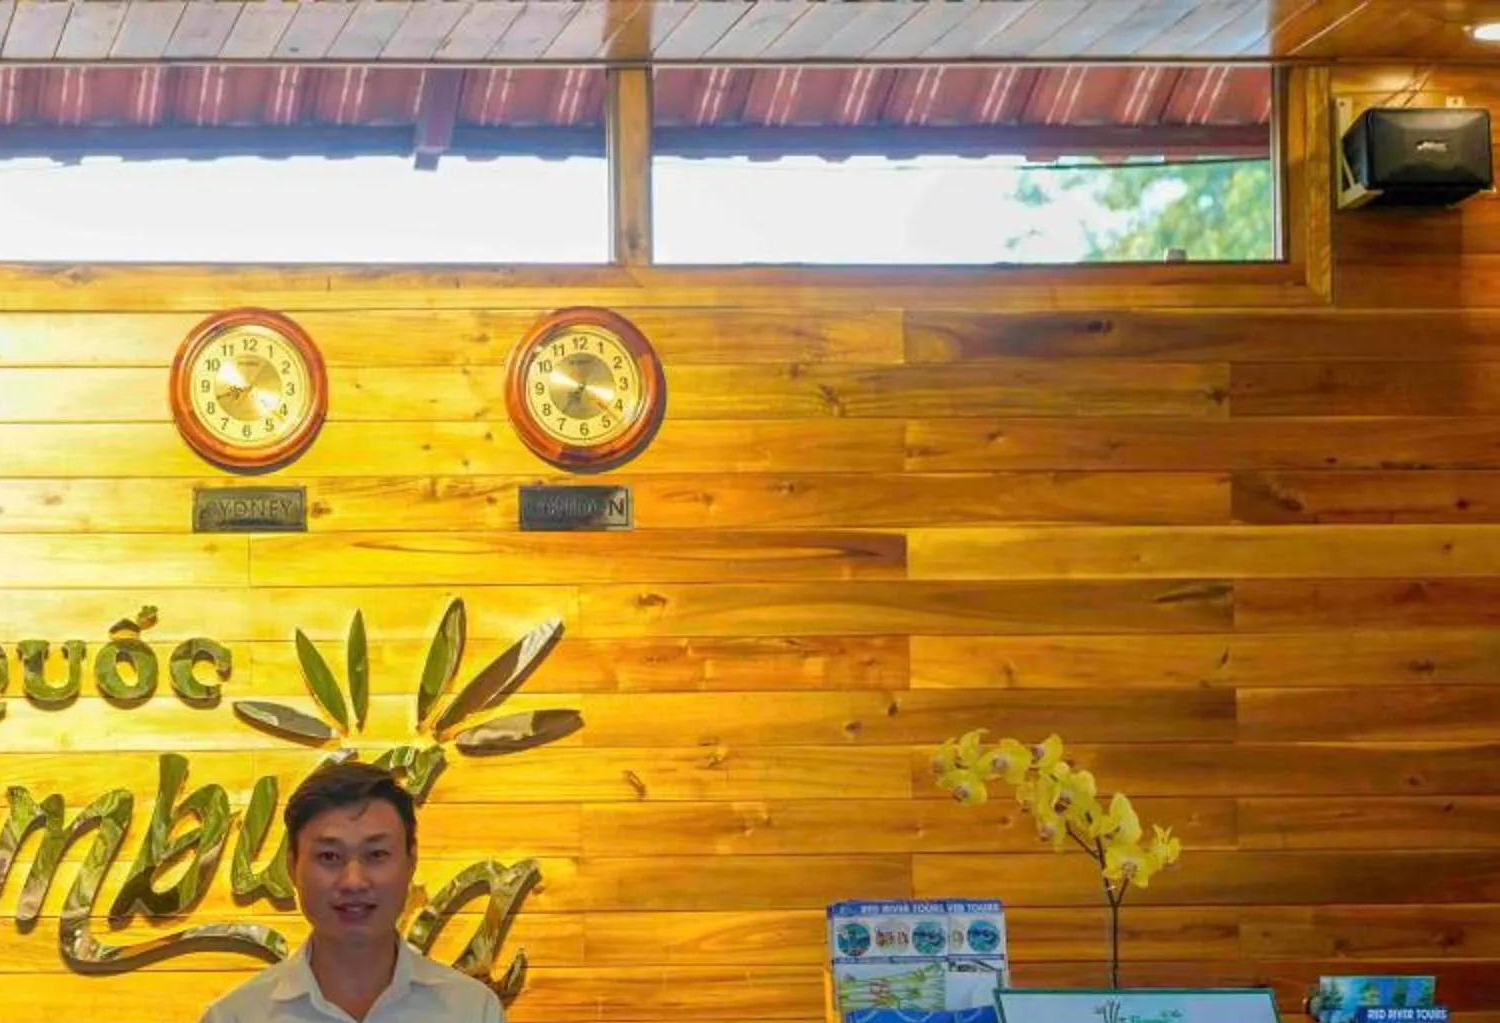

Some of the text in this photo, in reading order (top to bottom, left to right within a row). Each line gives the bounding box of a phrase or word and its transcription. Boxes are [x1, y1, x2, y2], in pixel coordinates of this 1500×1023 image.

[221, 343, 235, 357] 11
[241, 338, 258, 352] 12
[550, 343, 565, 357] 11
[571, 335, 589, 351] 12
[205, 358, 221, 372] 10
[280, 360, 291, 374] 2
[536, 359, 553, 374] 10
[612, 355, 623, 369] 2
[201, 379, 211, 393] 9
[285, 381, 295, 396] 3
[534, 381, 545, 396] 9
[619, 376, 629, 391] 3
[205, 401, 215, 415] 8
[279, 403, 289, 416] 4
[541, 403, 552, 417] 8
[613, 398, 624, 412] 4
[220, 417, 229, 431] 7
[264, 418, 275, 432] 5
[556, 417, 567, 431] 7
[579, 421, 590, 436] 6
[601, 414, 612, 429] 5
[241, 424, 252, 438] 6
[206, 499, 293, 518] YDNEY
